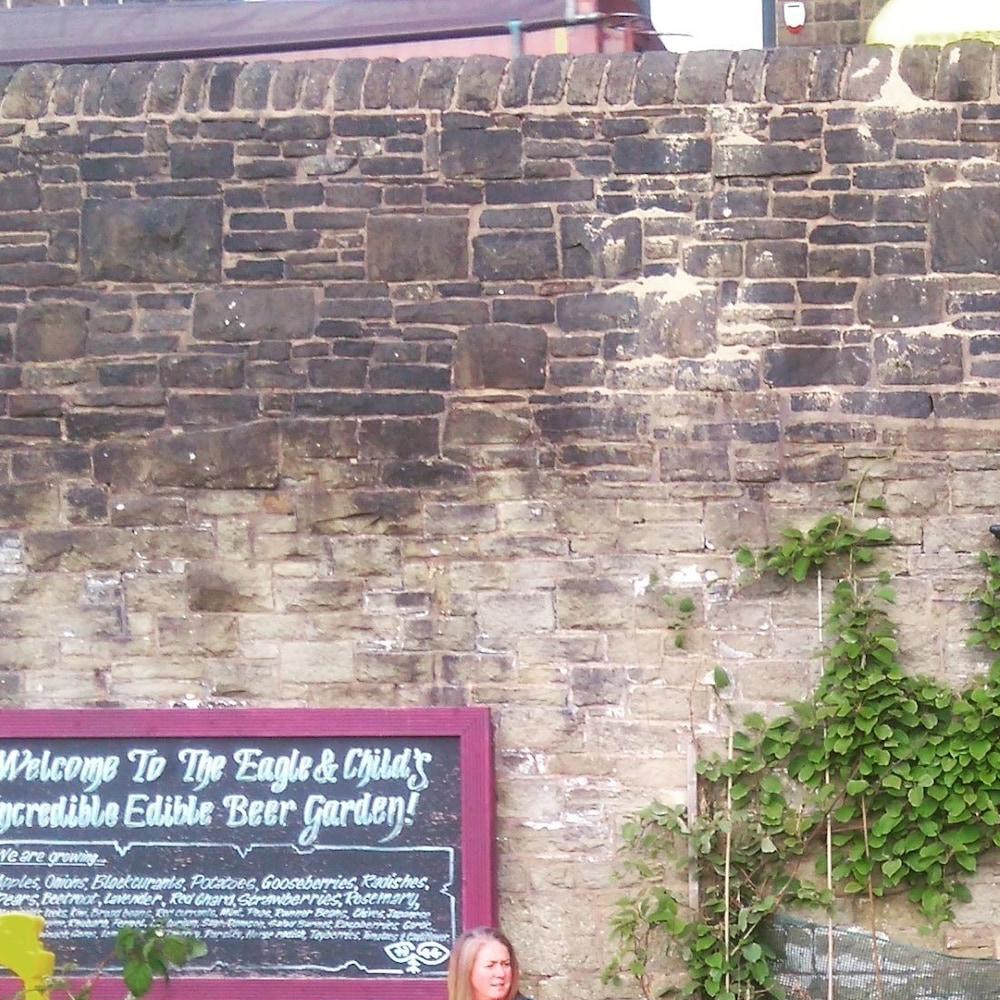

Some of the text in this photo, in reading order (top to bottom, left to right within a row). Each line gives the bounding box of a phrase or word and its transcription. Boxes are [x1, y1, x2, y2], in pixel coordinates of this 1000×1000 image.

[0, 748, 120, 793] Welcome
[127, 748, 167, 783] To
[178, 747, 227, 791] The
[233, 748, 313, 793] Eagle
[312, 748, 339, 784] &
[0, 791, 421, 846] ncredible Edible Beer Garden!
[19, 850, 46, 863] are
